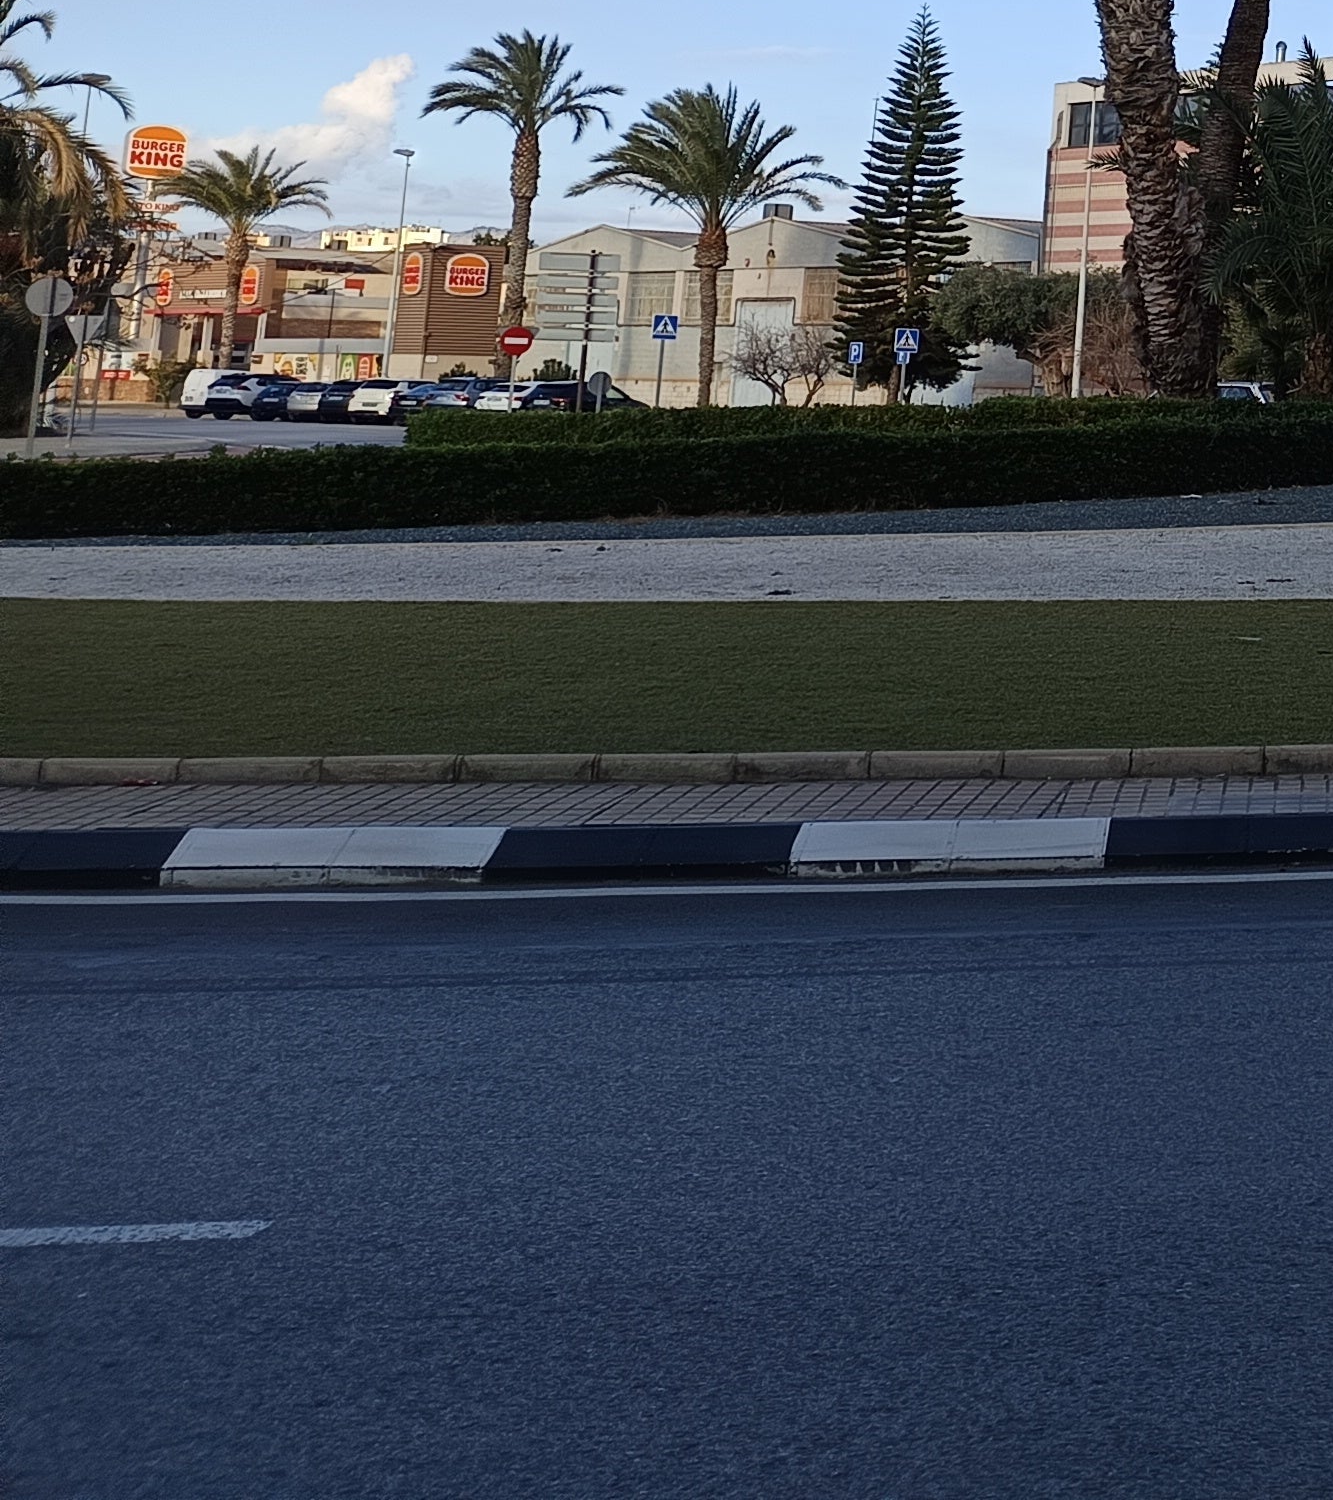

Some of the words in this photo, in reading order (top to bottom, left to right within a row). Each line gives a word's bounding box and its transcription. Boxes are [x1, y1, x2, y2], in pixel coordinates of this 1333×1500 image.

[131, 139, 185, 153] BURGER
[129, 150, 184, 168] KING
[449, 267, 486, 276] BURGER
[448, 276, 485, 287] KING
[851, 344, 859, 361] P
